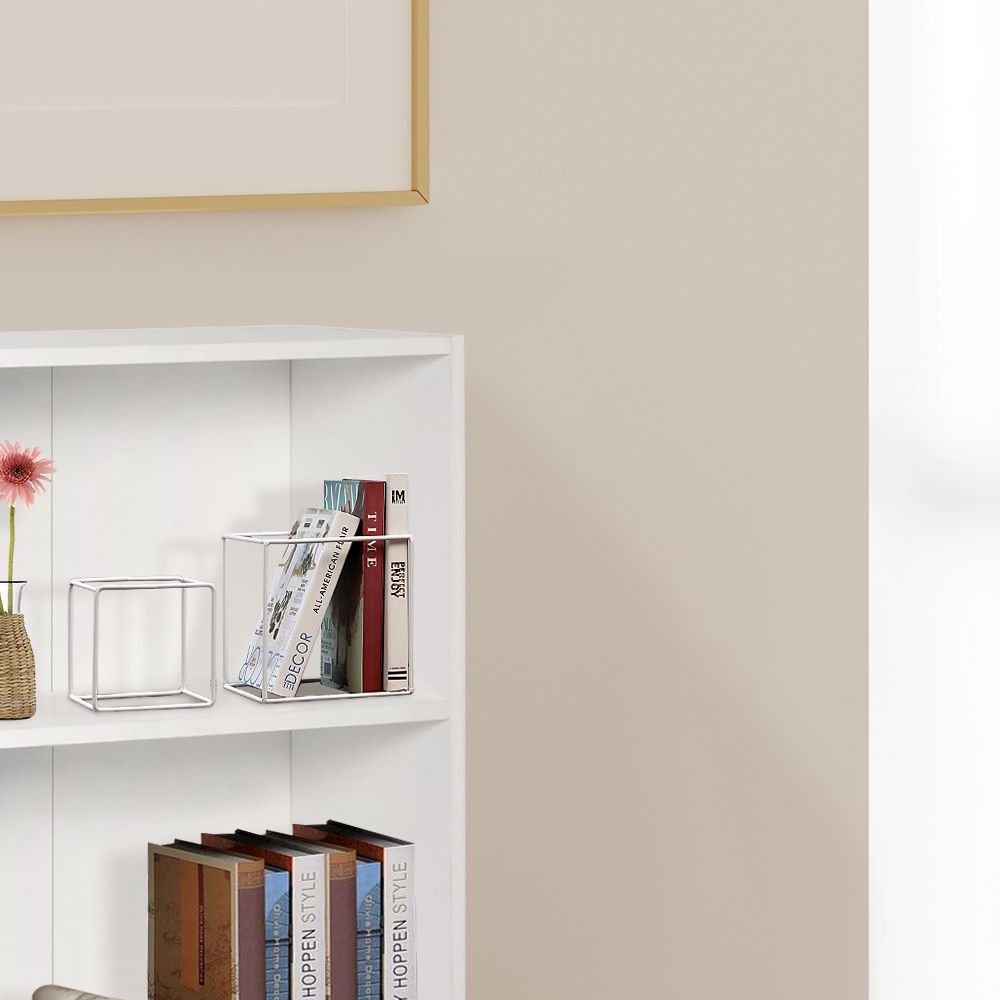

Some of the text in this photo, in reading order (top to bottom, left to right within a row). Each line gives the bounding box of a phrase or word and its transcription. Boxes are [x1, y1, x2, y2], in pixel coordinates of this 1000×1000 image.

[367, 512, 377, 568] TIME
[312, 551, 340, 615] ALL-AMERICAN
[390, 561, 400, 599] ENJOY
[284, 632, 313, 686] DECOR
[301, 871, 317, 923] STYLE
[392, 862, 408, 914] STYLE
[301, 929, 317, 998] HOPPEN
[364, 928, 372, 961] Home
[392, 919, 408, 989] HOPPEN
